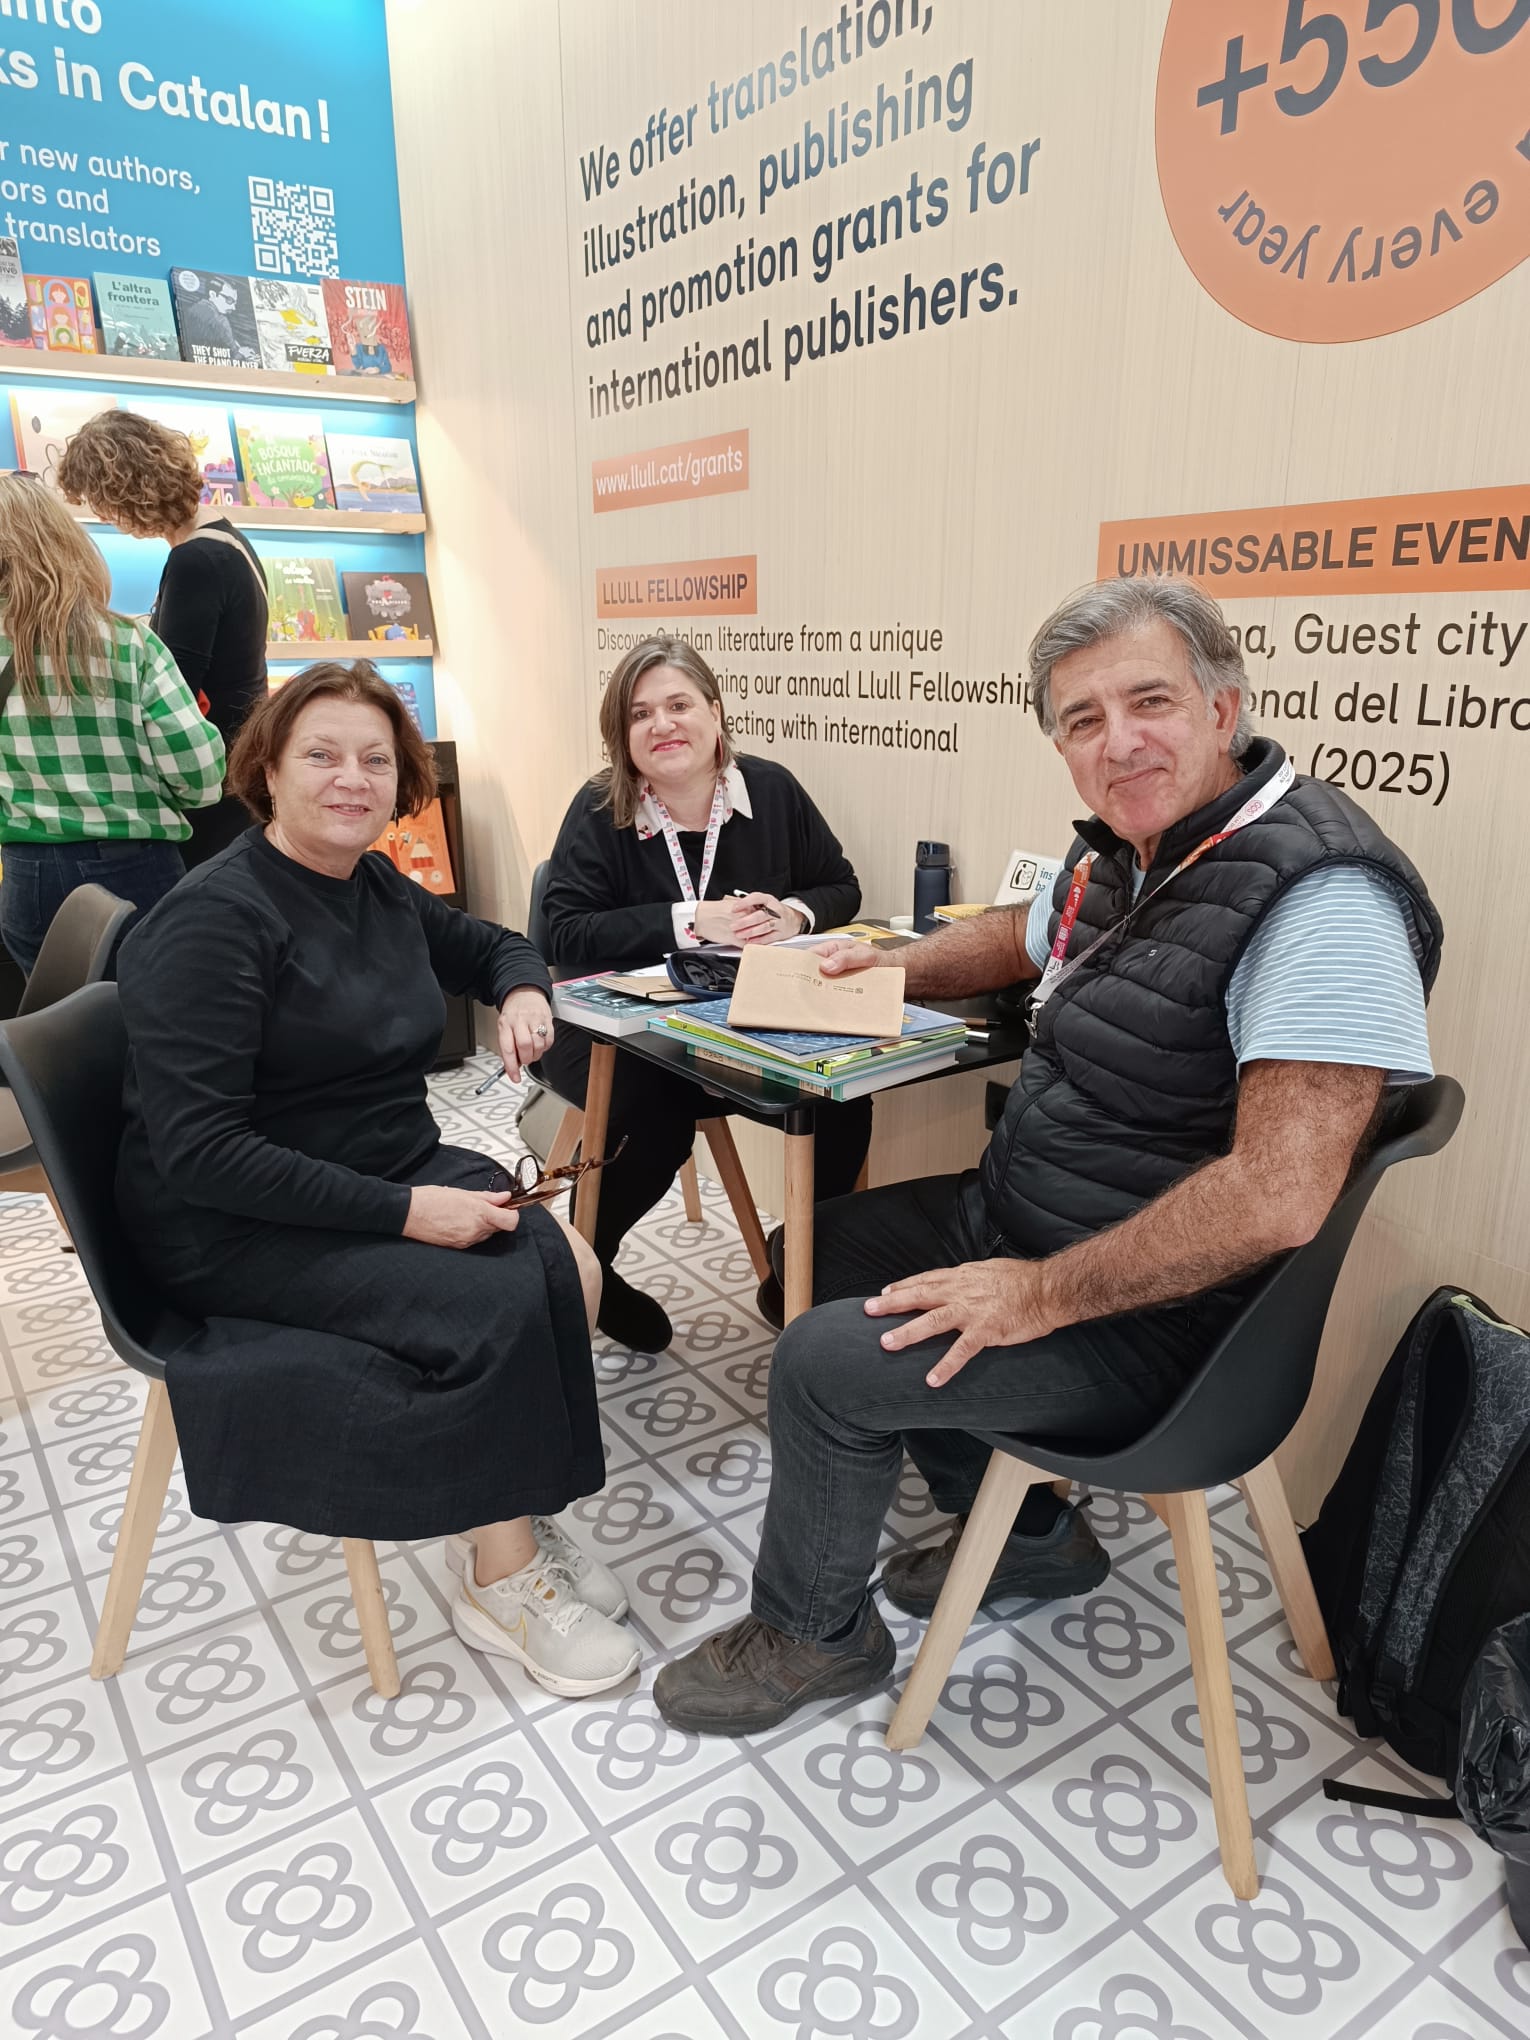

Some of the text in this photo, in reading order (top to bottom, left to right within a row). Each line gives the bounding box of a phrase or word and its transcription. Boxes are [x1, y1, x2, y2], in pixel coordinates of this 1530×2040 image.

[54, 45, 103, 102] in
[119, 61, 331, 144] Catalan!
[579, 0, 934, 202] We offer translation,
[20, 143, 78, 173] new
[88, 155, 201, 195] authors,
[583, 57, 974, 277] illustration, publishing
[56, 187, 110, 215] and
[5, 211, 161, 257] translators
[586, 137, 1041, 349] and promotion grants for
[1217, 179, 1500, 284] every year
[107, 291, 160, 306] frontera
[111, 281, 152, 295] L'altra
[344, 286, 388, 312] STEIN
[191, 344, 231, 359] THEY SHOT
[287, 345, 330, 362] FUERZA
[589, 261, 1019, 420] international publishers.
[596, 445, 743, 496] www.llull.cat/grants
[1117, 515, 1530, 578] UNMISSABLE EVEN
[603, 573, 748, 605] LLULL FELLOWSHIP
[718, 626, 794, 652] literature
[800, 625, 842, 652] from
[850, 631, 862, 651] a
[869, 622, 943, 659] unique
[1227, 610, 1528, 667] na, Guest city
[754, 676, 781, 696] our
[787, 671, 850, 699] annual
[858, 671, 901, 701] Llull
[909, 671, 1034, 714] Fellowship
[1334, 681, 1399, 724] del
[726, 714, 958, 753] ecting with international
[1310, 743, 1450, 805] (2025)
